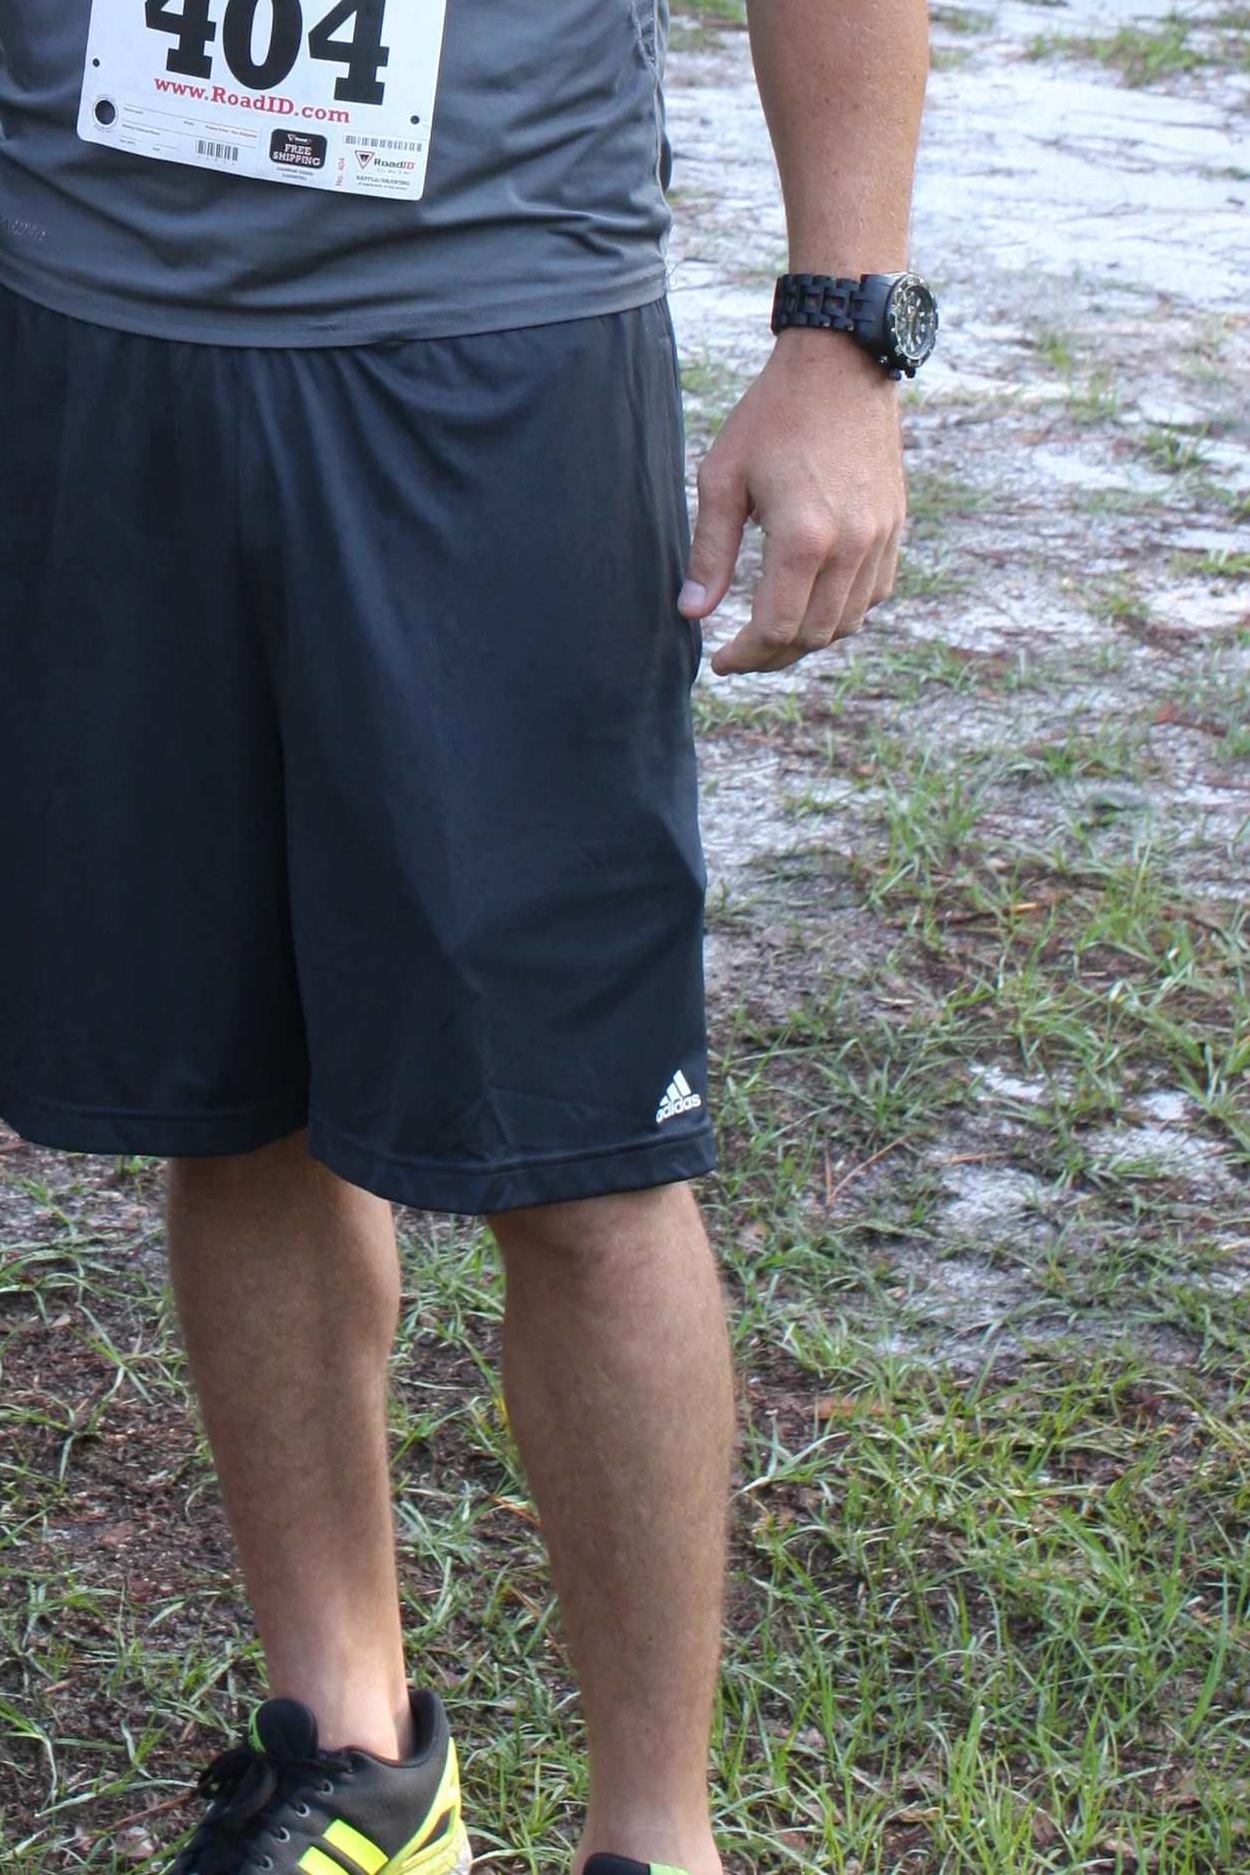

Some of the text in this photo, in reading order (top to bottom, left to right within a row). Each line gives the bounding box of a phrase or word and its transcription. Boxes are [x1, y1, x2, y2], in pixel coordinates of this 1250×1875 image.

[154, 76, 350, 124] www.RoadID.com
[272, 151, 321, 167] SHIPPING
[284, 143, 312, 156] FREE
[655, 1093, 702, 1124] adidas
